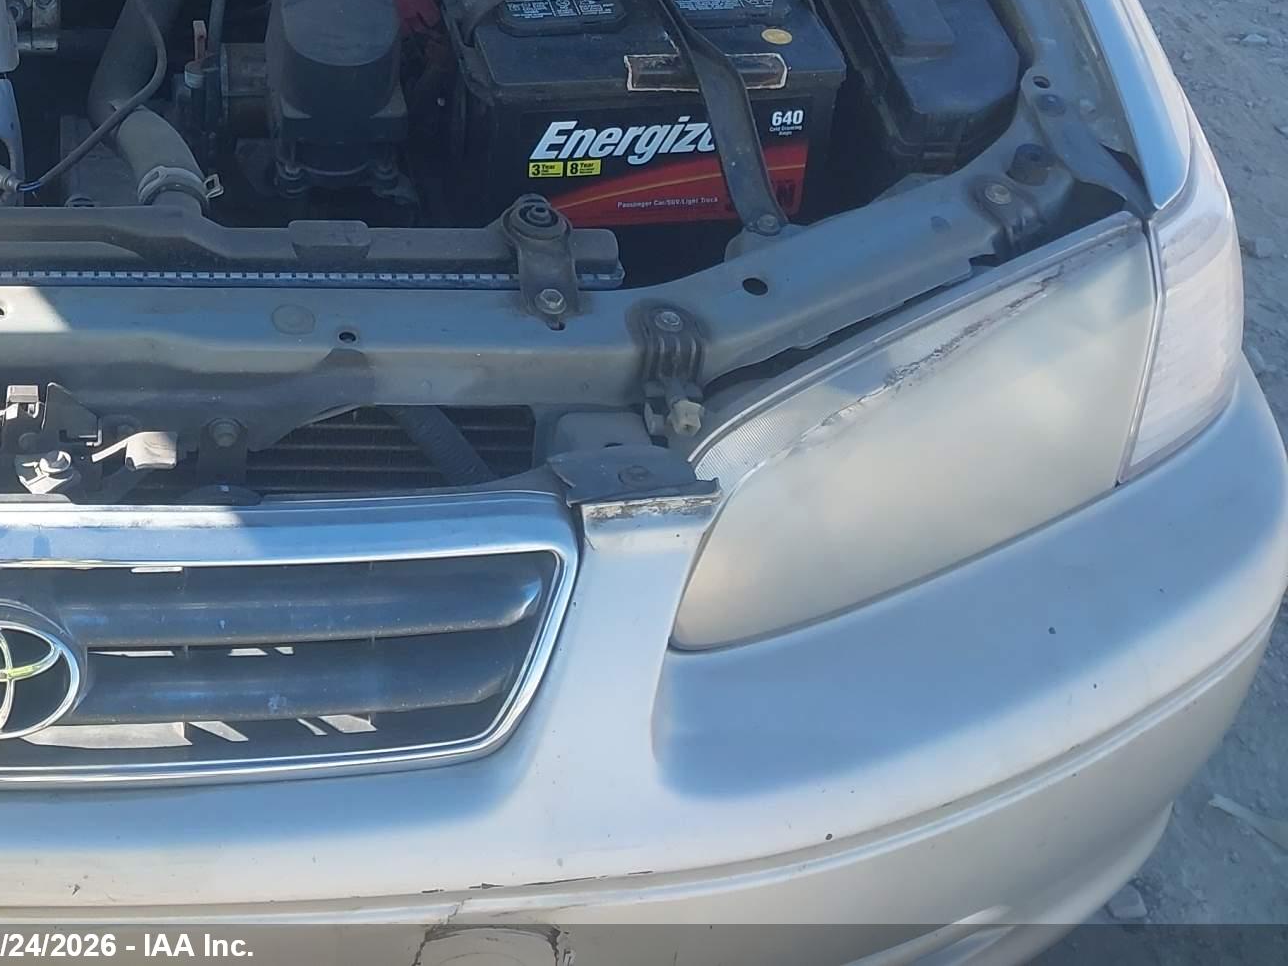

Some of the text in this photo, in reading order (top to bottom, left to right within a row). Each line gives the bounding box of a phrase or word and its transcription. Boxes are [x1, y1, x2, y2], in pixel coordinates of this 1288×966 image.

[772, 110, 804, 126] 640
[532, 164, 540, 176] 3
[570, 163, 578, 175] 8
